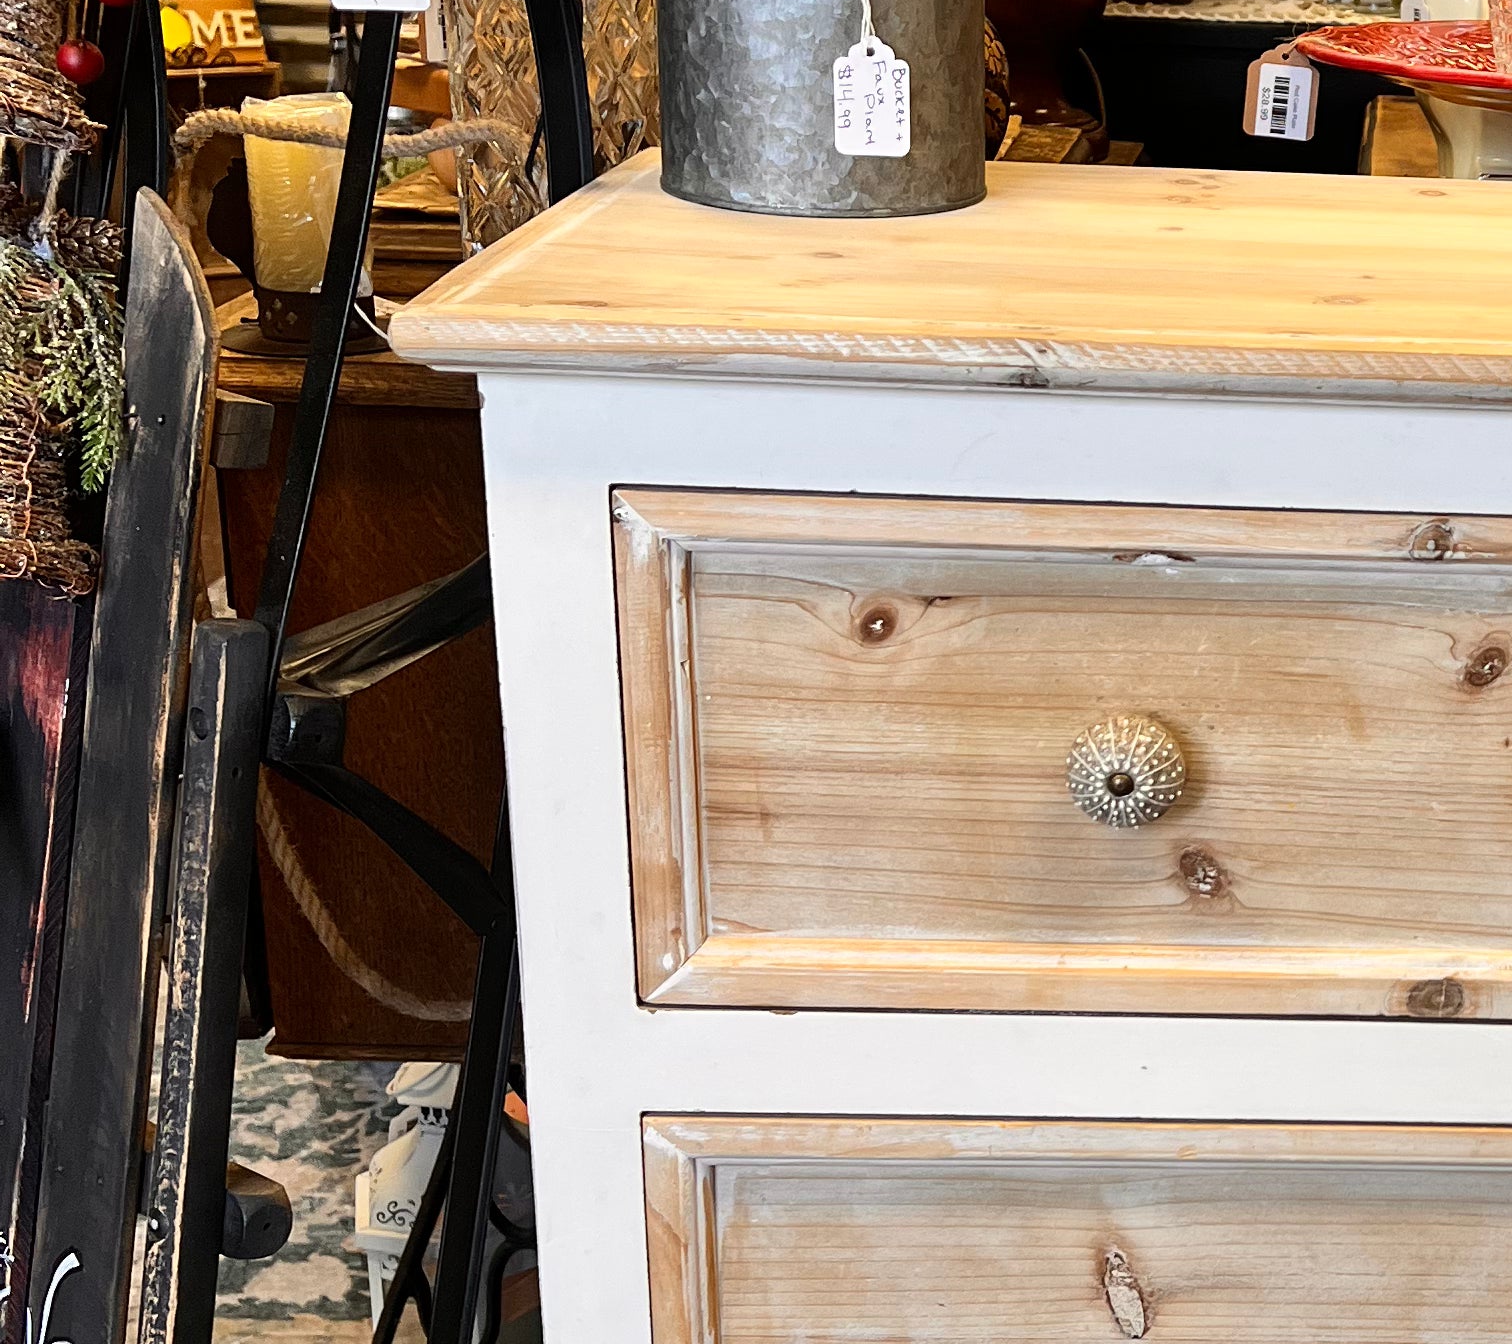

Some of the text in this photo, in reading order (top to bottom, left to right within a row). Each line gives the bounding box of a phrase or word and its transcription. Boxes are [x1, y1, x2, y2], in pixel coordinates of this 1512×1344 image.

[183, 8, 265, 48] ME
[836, 64, 855, 129] $14.99
[873, 60, 887, 106] Faux
